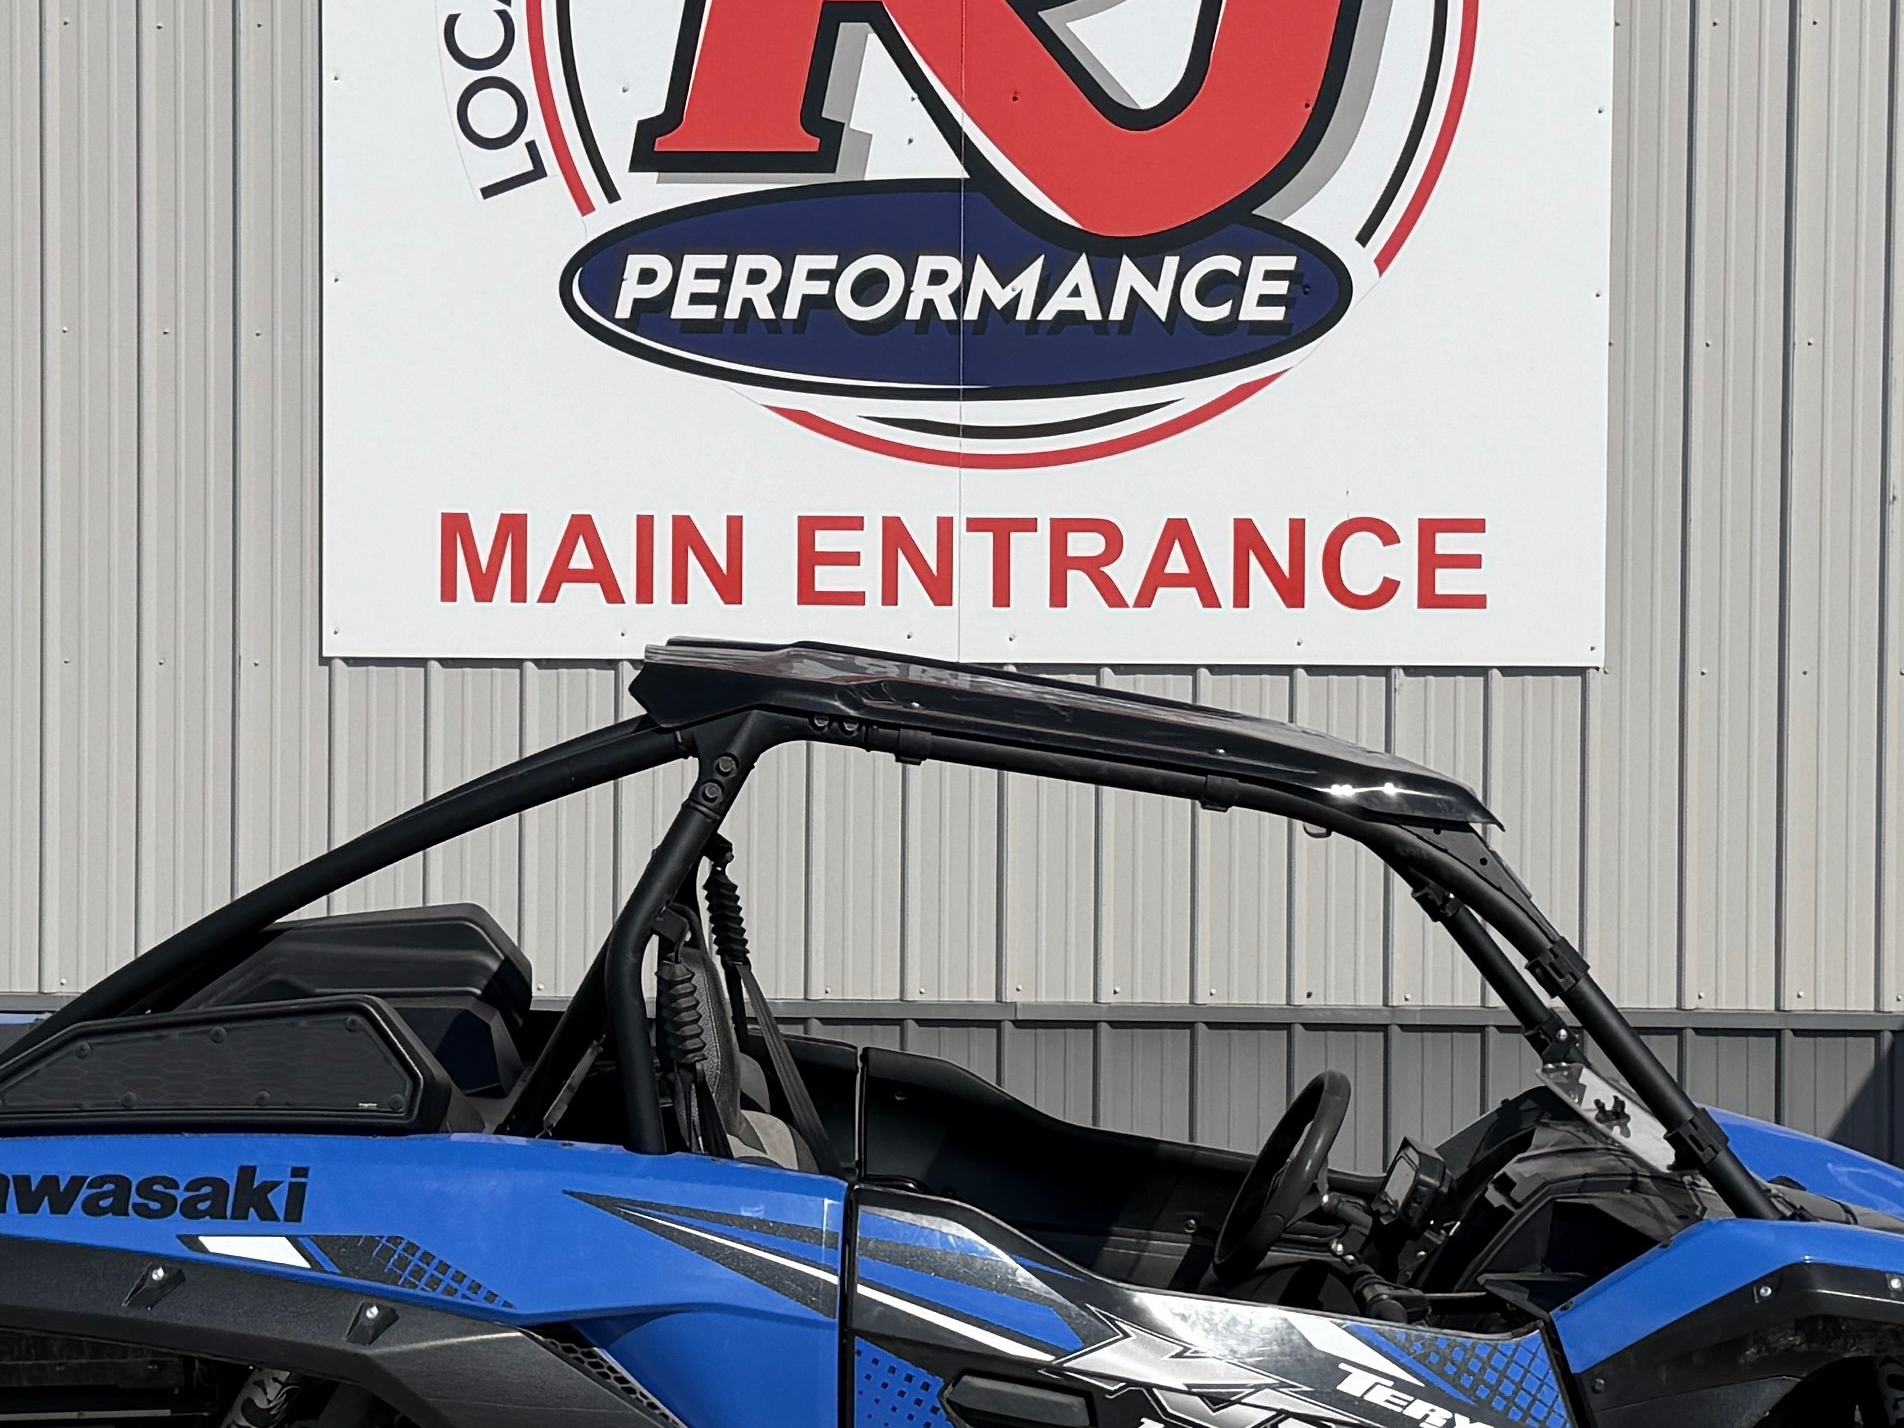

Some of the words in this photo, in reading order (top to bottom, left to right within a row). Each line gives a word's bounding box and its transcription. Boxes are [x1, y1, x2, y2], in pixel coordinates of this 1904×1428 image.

[613, 253, 1299, 323] PERFORMANCE
[440, 513, 744, 606] MAIN
[796, 515, 1489, 611] ENTRANCE
